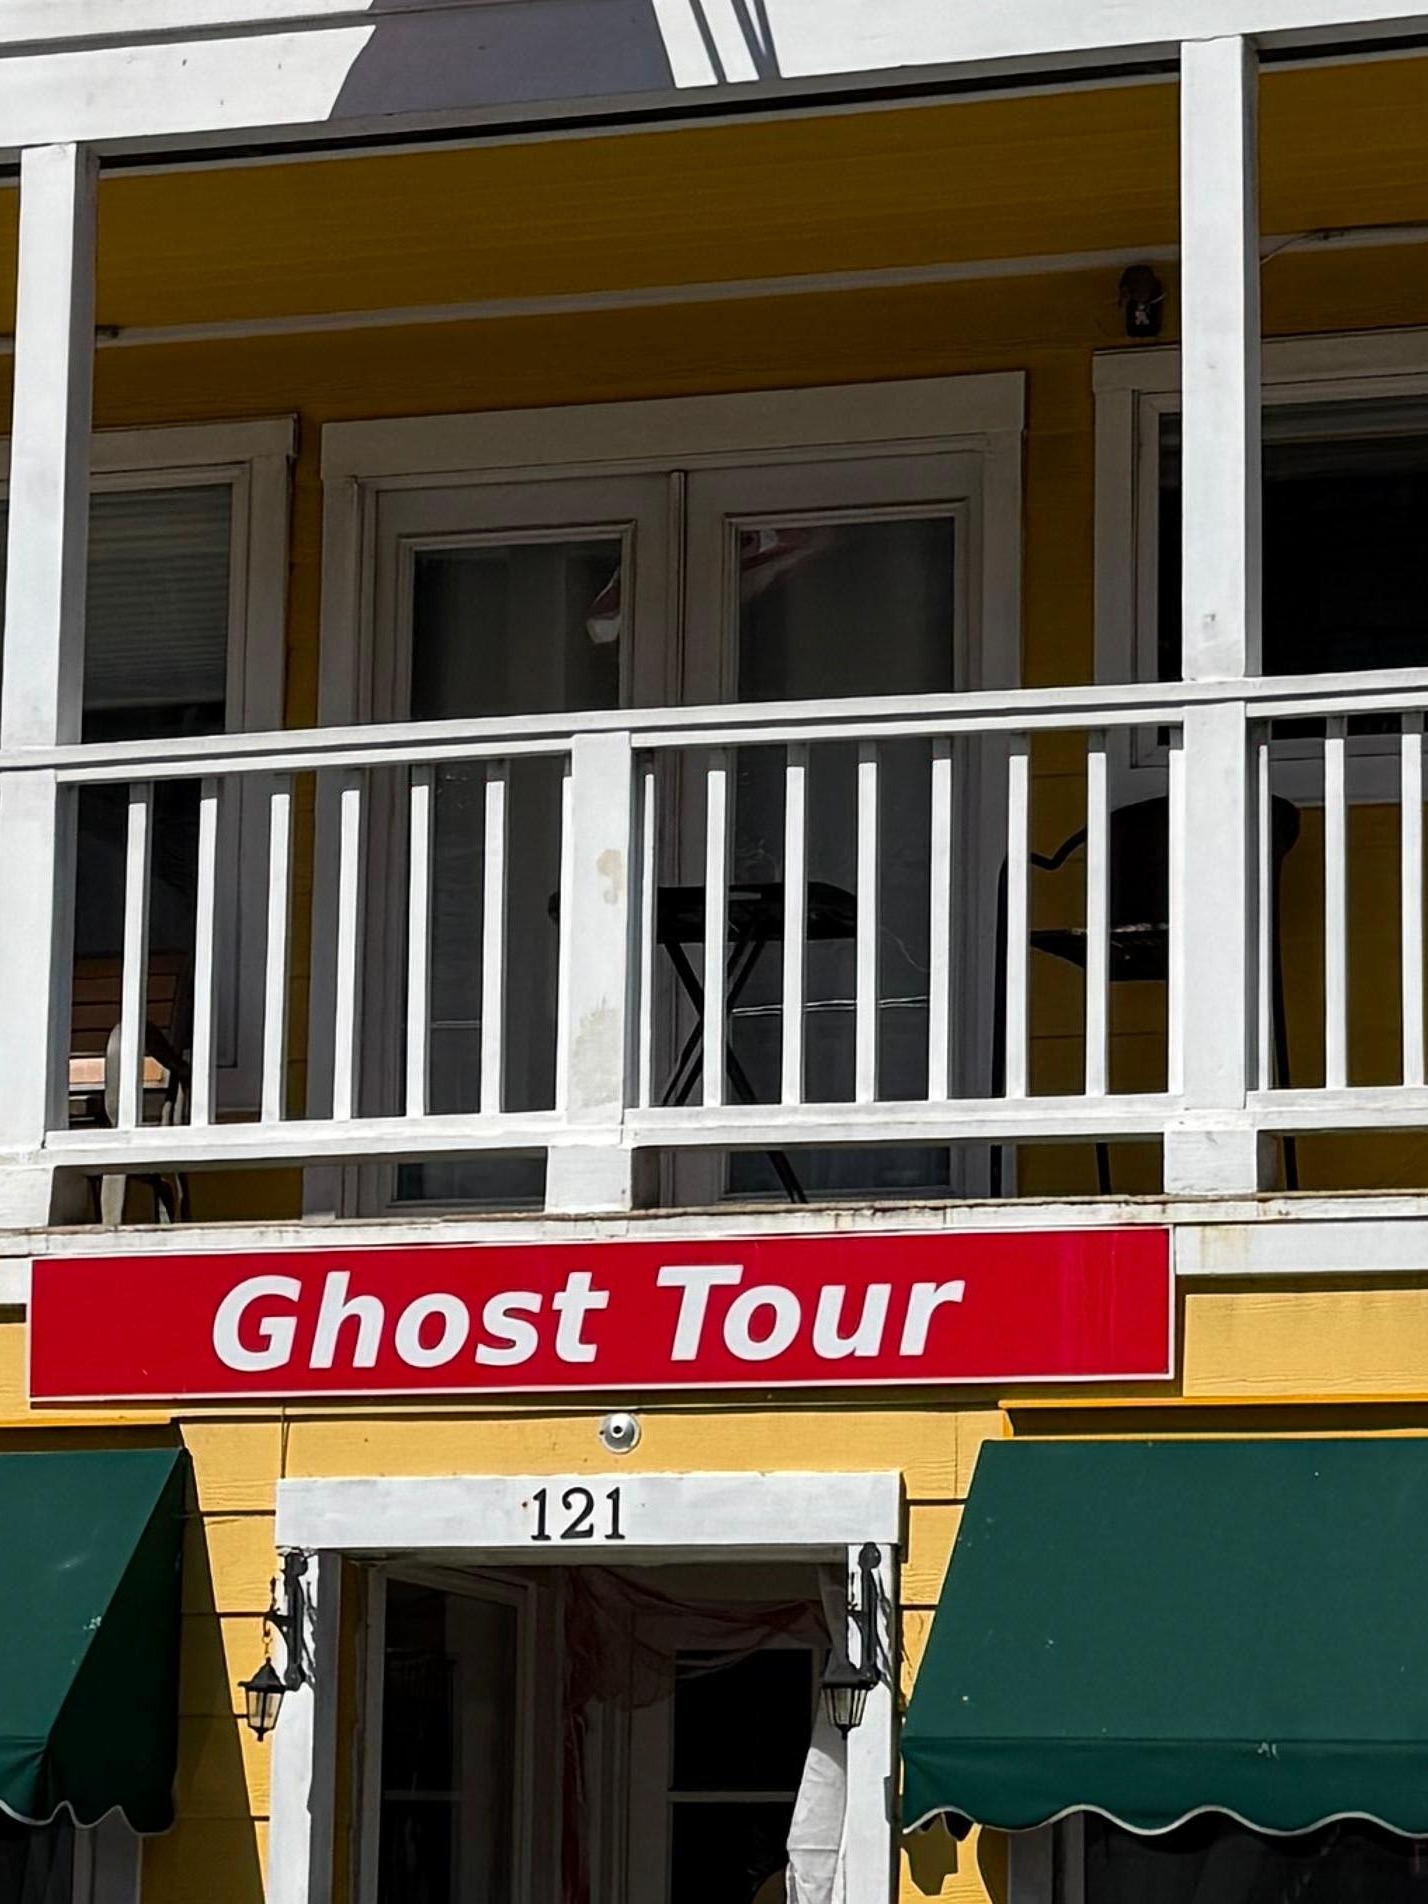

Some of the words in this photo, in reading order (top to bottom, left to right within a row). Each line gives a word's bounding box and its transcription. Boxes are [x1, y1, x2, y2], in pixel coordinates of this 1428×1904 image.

[213, 1272, 609, 1372] Ghost
[658, 1264, 965, 1361] Tour
[529, 1486, 626, 1541] 121
